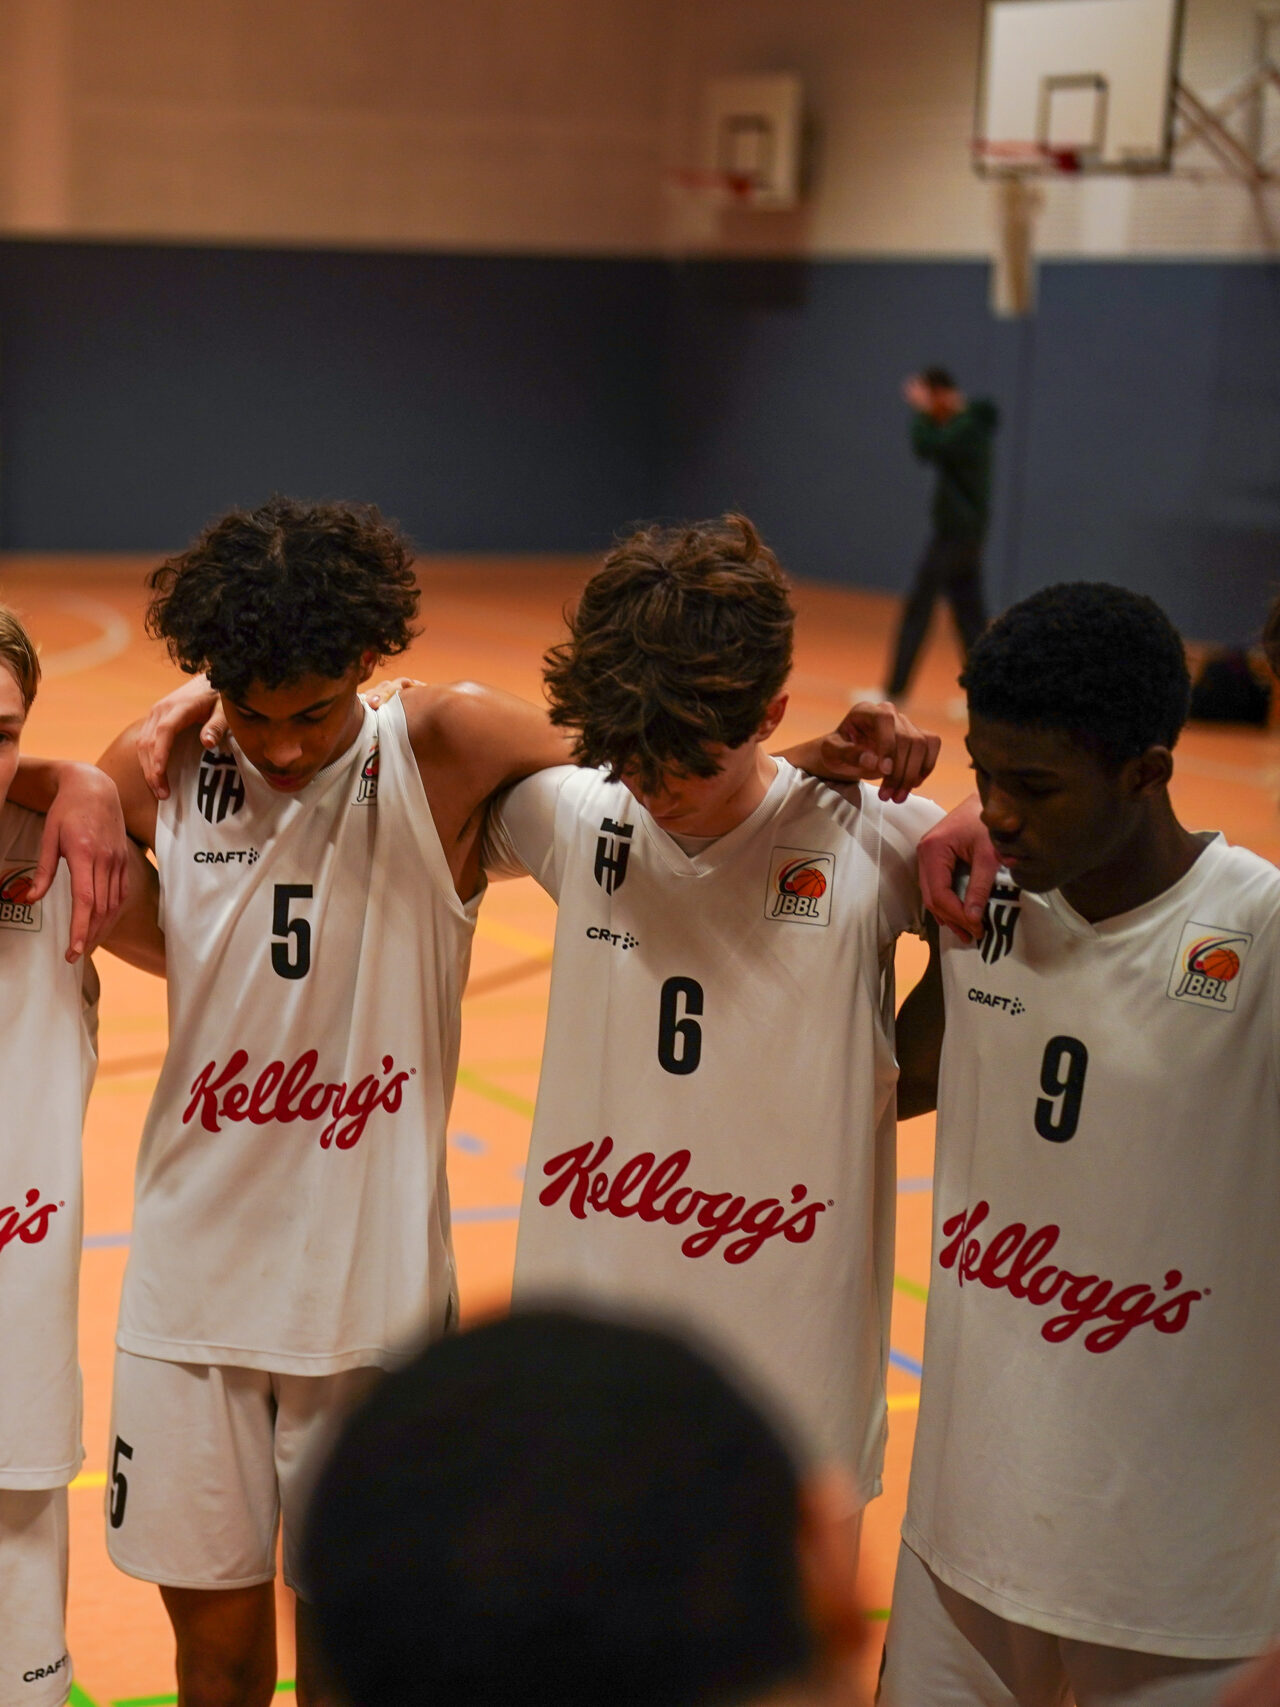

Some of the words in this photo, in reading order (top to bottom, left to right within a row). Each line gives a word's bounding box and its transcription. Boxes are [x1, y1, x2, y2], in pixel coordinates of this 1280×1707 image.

[193, 850, 247, 864] CRAFT
[271, 884, 313, 980] 5
[772, 893, 819, 918] JBBL
[657, 976, 705, 1076] 6
[968, 987, 1012, 1011] CRAFT
[1175, 971, 1227, 1003] JBBL
[182, 1048, 410, 1150] Kellogg's
[1034, 1035, 1089, 1144] 9
[538, 1136, 827, 1265] Kellogg's
[938, 1199, 1202, 1354] Kellogg's
[110, 1435, 134, 1529] 5
